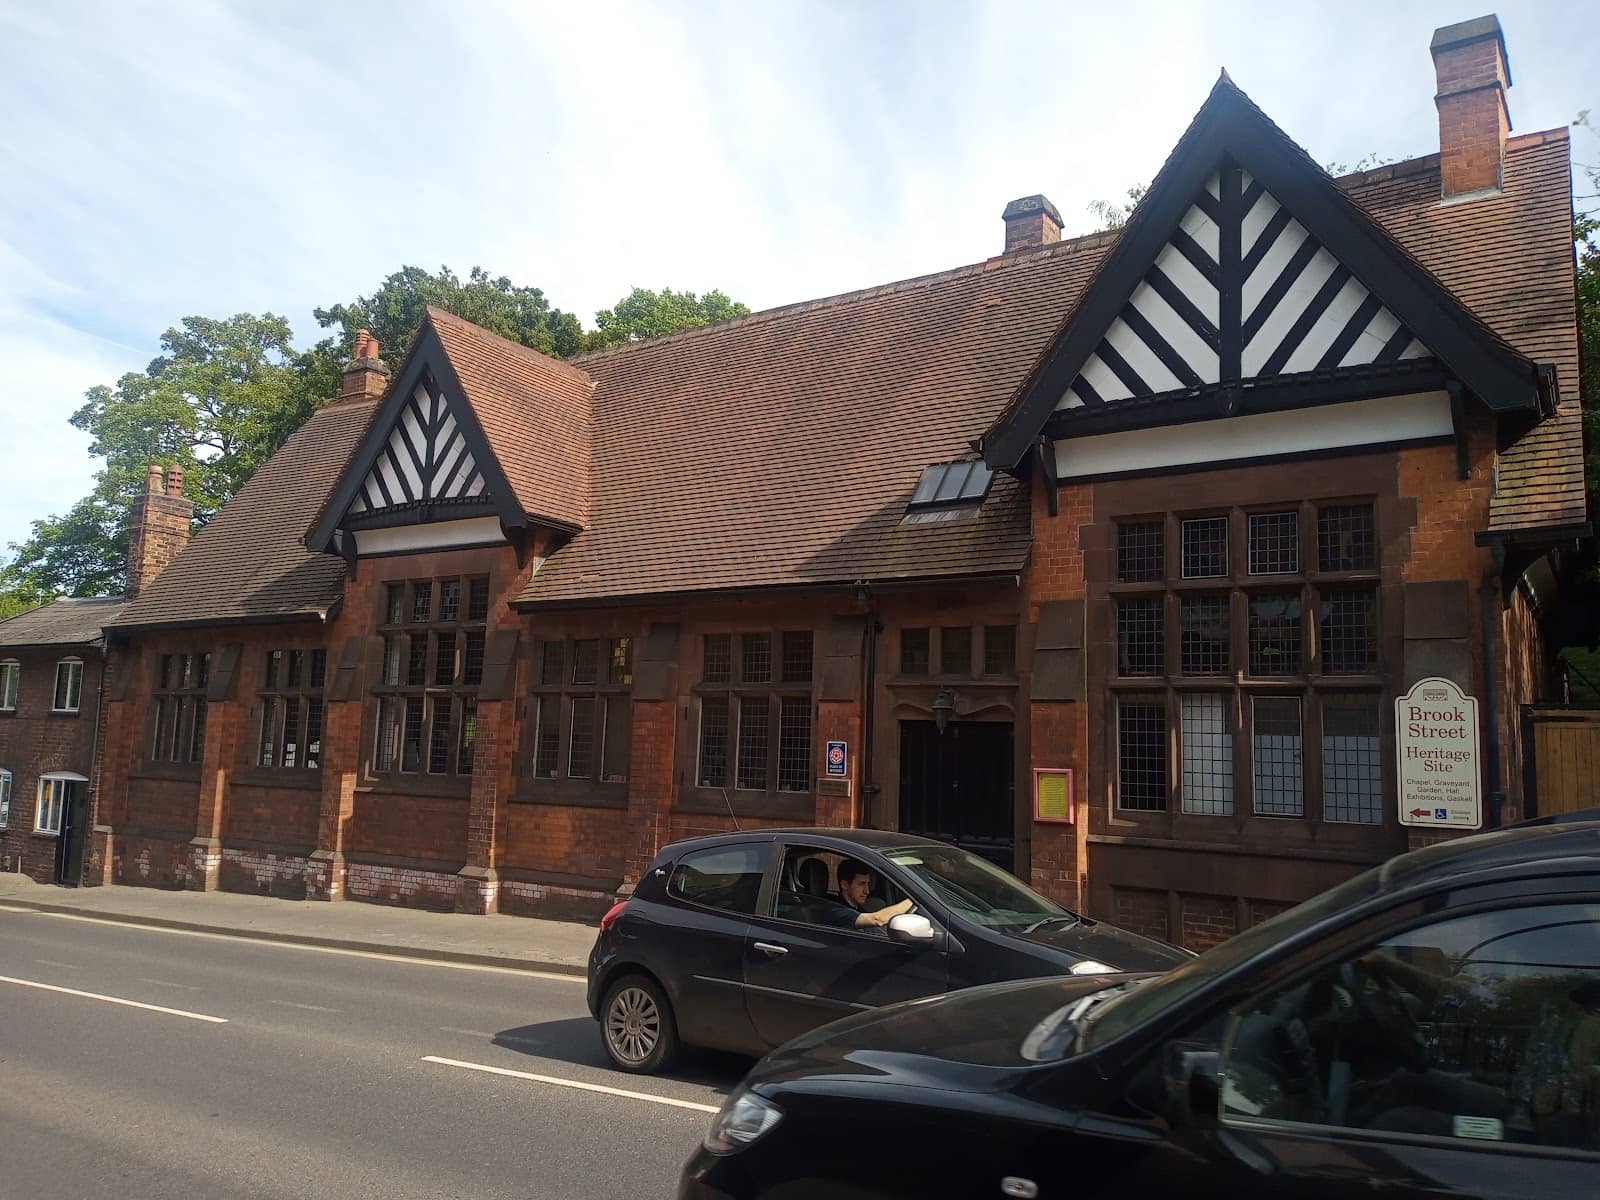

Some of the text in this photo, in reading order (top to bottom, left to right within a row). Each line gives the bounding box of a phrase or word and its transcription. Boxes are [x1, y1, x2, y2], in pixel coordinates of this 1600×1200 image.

[1408, 706, 1466, 722] Brook
[1408, 723, 1467, 739] Street
[1407, 746, 1471, 762] Heritage
[1424, 759, 1453, 772] Site
[1434, 780, 1472, 788] Graveyard,
